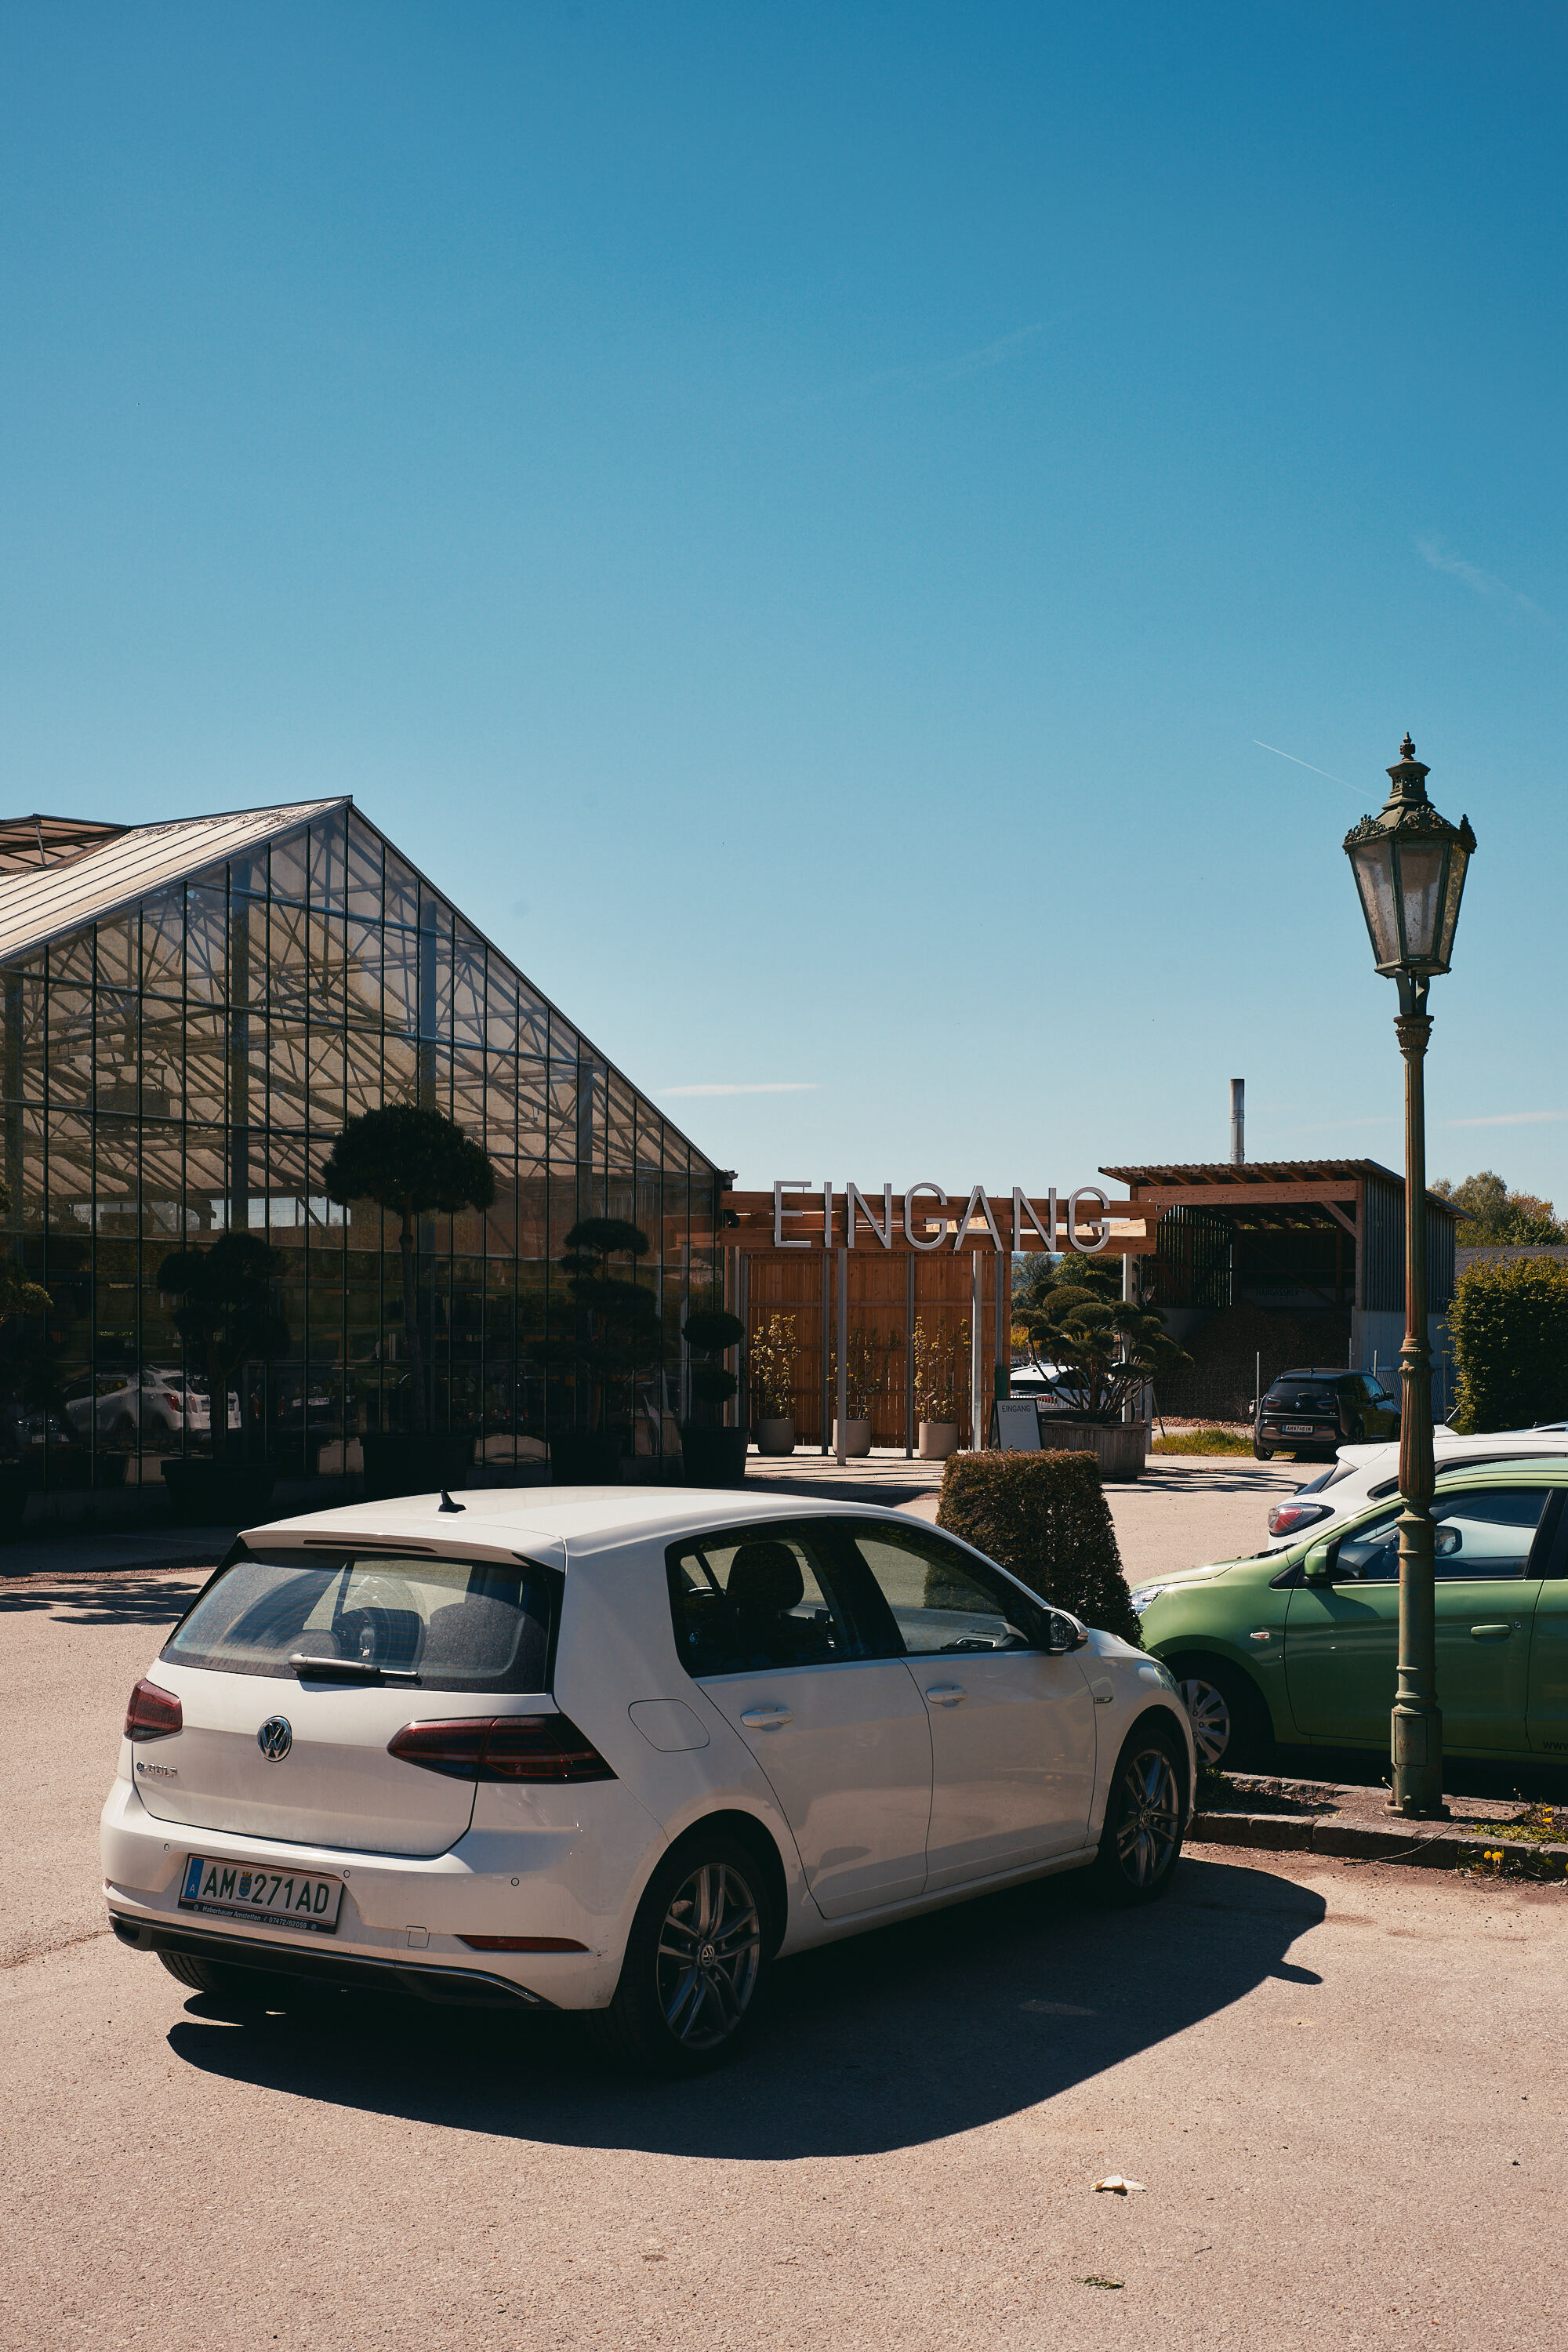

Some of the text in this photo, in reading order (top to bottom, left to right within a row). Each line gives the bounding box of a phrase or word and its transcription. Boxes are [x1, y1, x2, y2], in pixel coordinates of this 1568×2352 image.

[774, 1180, 1111, 1253] EINGANG
[190, 1884, 195, 1893] A
[202, 1867, 237, 1900] AM
[202, 1905, 307, 1929] Haberhauer Amstetten 07472/62059
